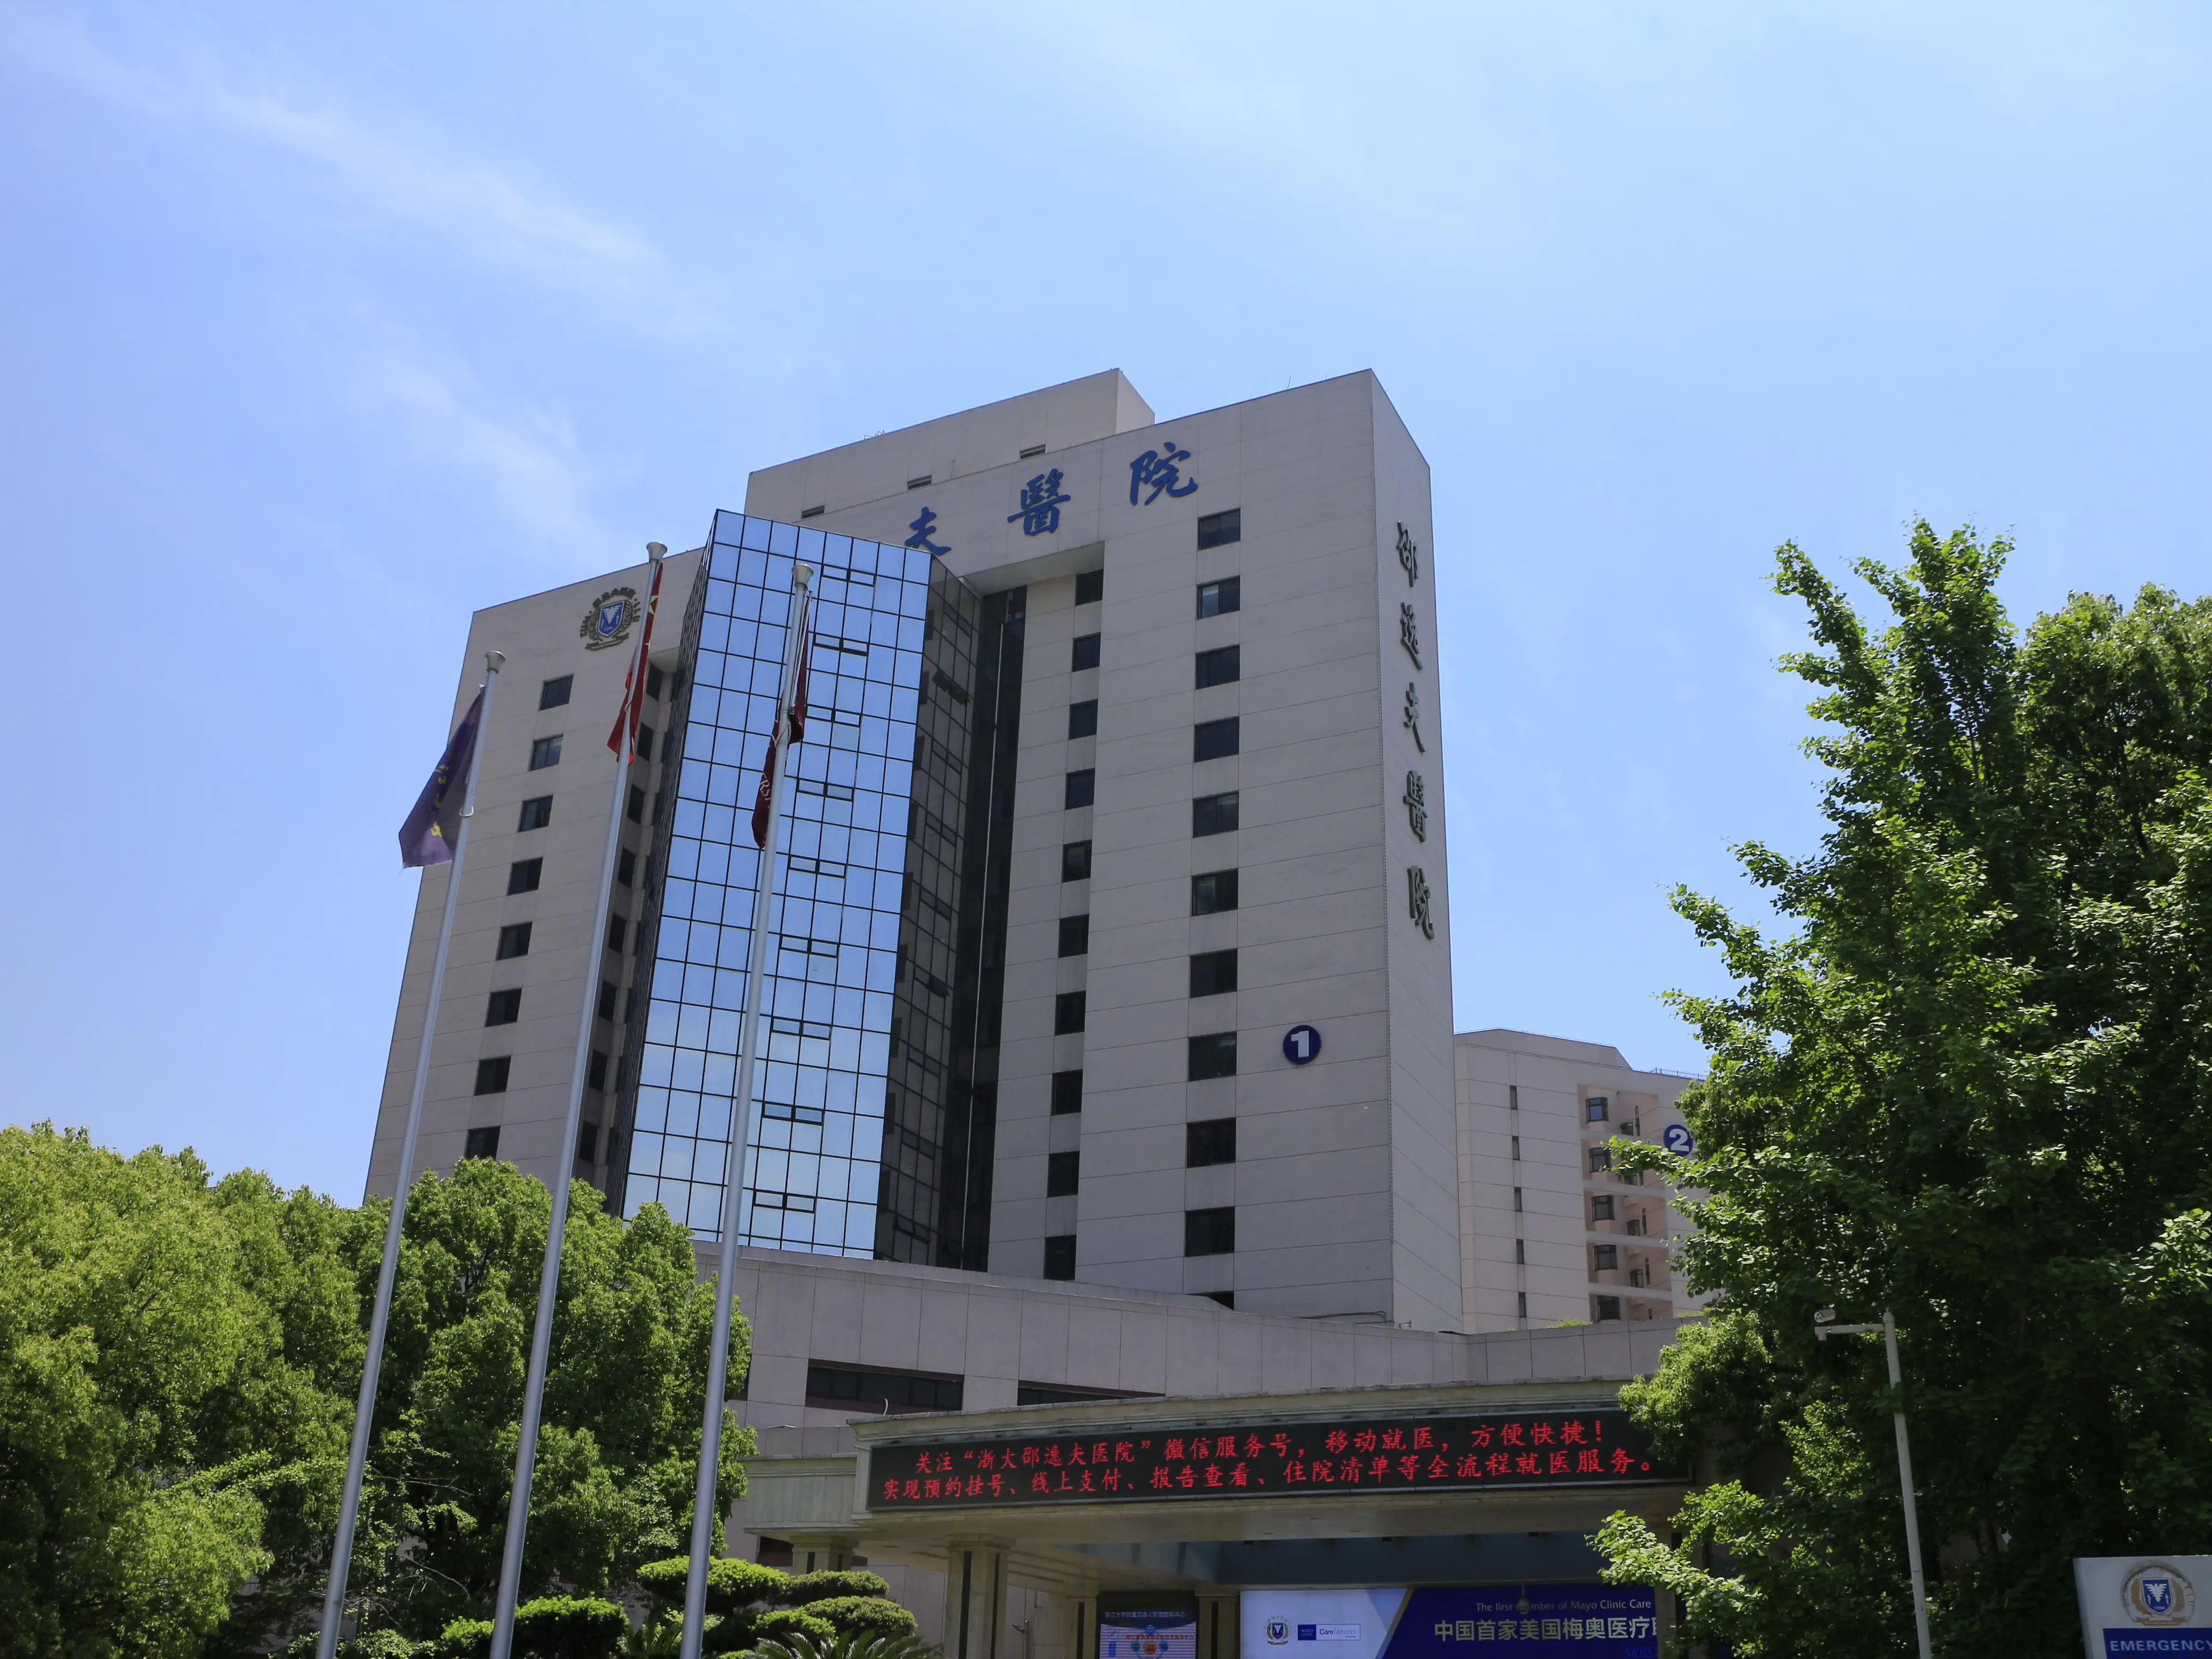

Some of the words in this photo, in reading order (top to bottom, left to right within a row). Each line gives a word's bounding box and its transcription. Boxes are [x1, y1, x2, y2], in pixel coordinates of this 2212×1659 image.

[1396, 521, 1435, 940] 邵逸夫醫院
[1291, 1030, 1309, 1058] 1
[1669, 1128, 1690, 1152] 2
[1476, 1603, 1493, 1612] The
[1495, 1602, 1512, 1611] first
[1516, 1601, 1554, 1611] mber
[1558, 1601, 1567, 1610] of
[1570, 1600, 1597, 1612] Mayo
[1600, 1600, 1627, 1609] Clinic
[1630, 1599, 1652, 1608] Care
